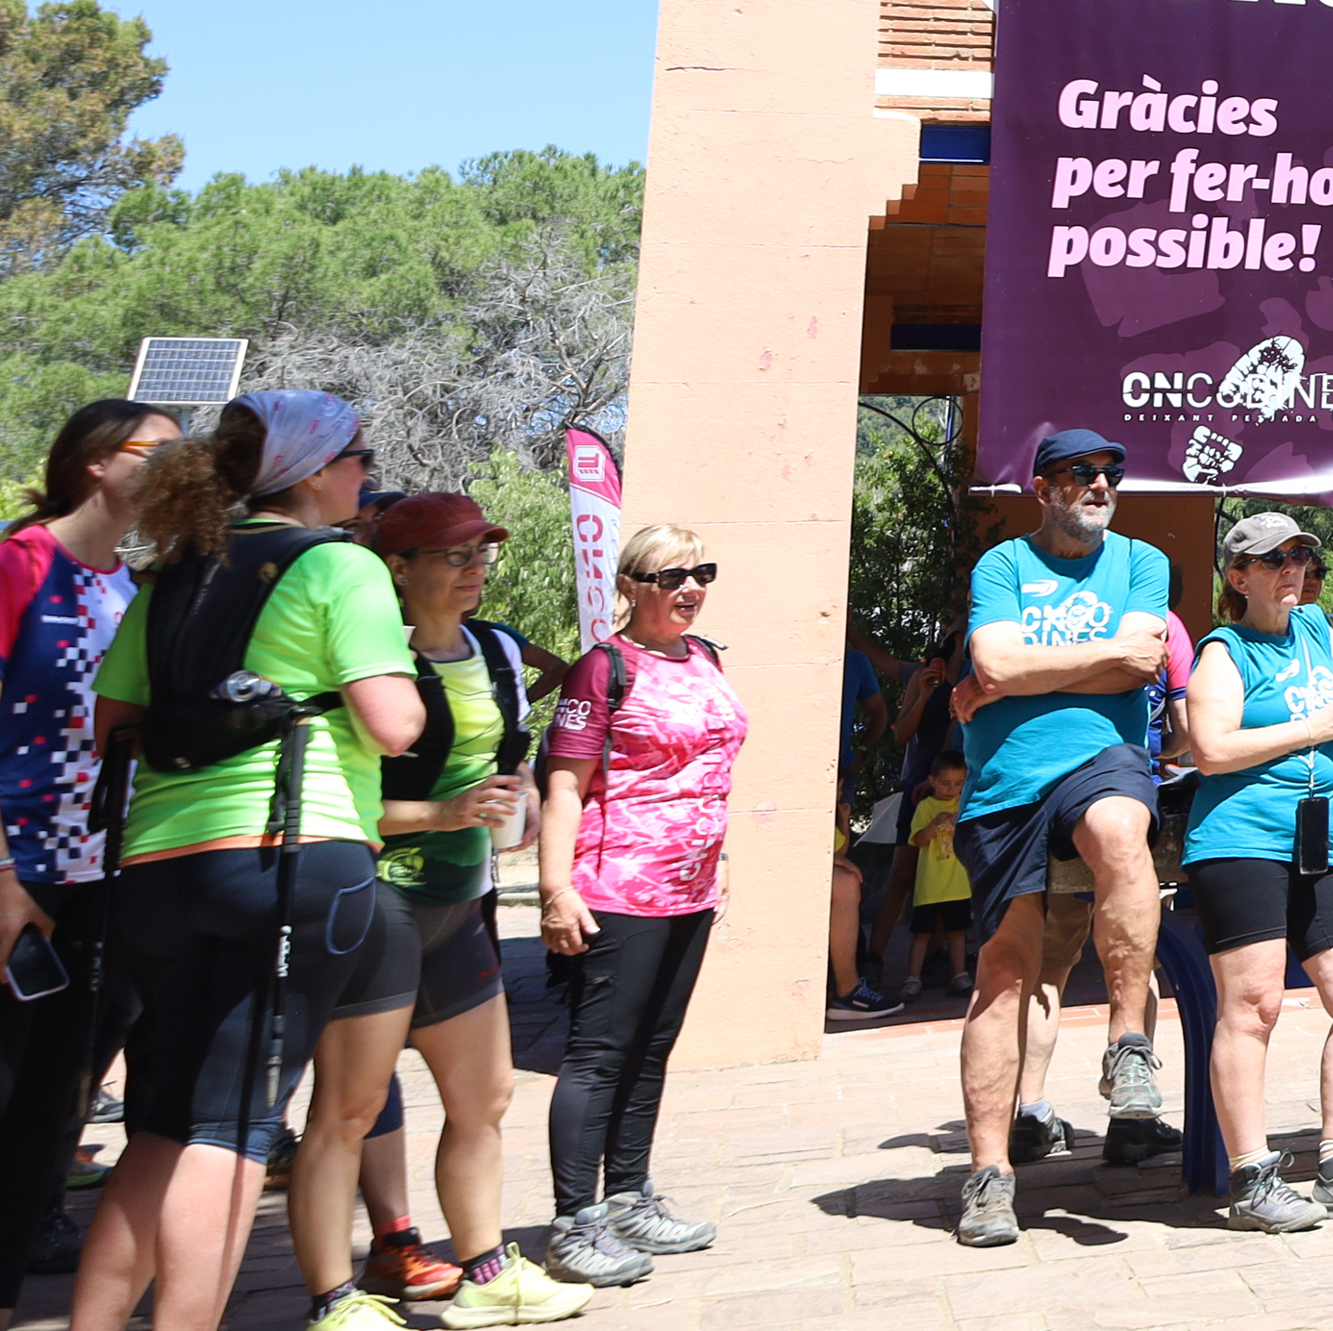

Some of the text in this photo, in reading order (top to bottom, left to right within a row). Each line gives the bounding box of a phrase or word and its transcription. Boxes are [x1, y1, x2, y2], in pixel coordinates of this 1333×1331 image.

[1057, 74, 1279, 137] Gràcies
[1052, 155, 1159, 209] per
[1047, 214, 1321, 278] possible!
[1123, 413, 1215, 422] DEIXANT
